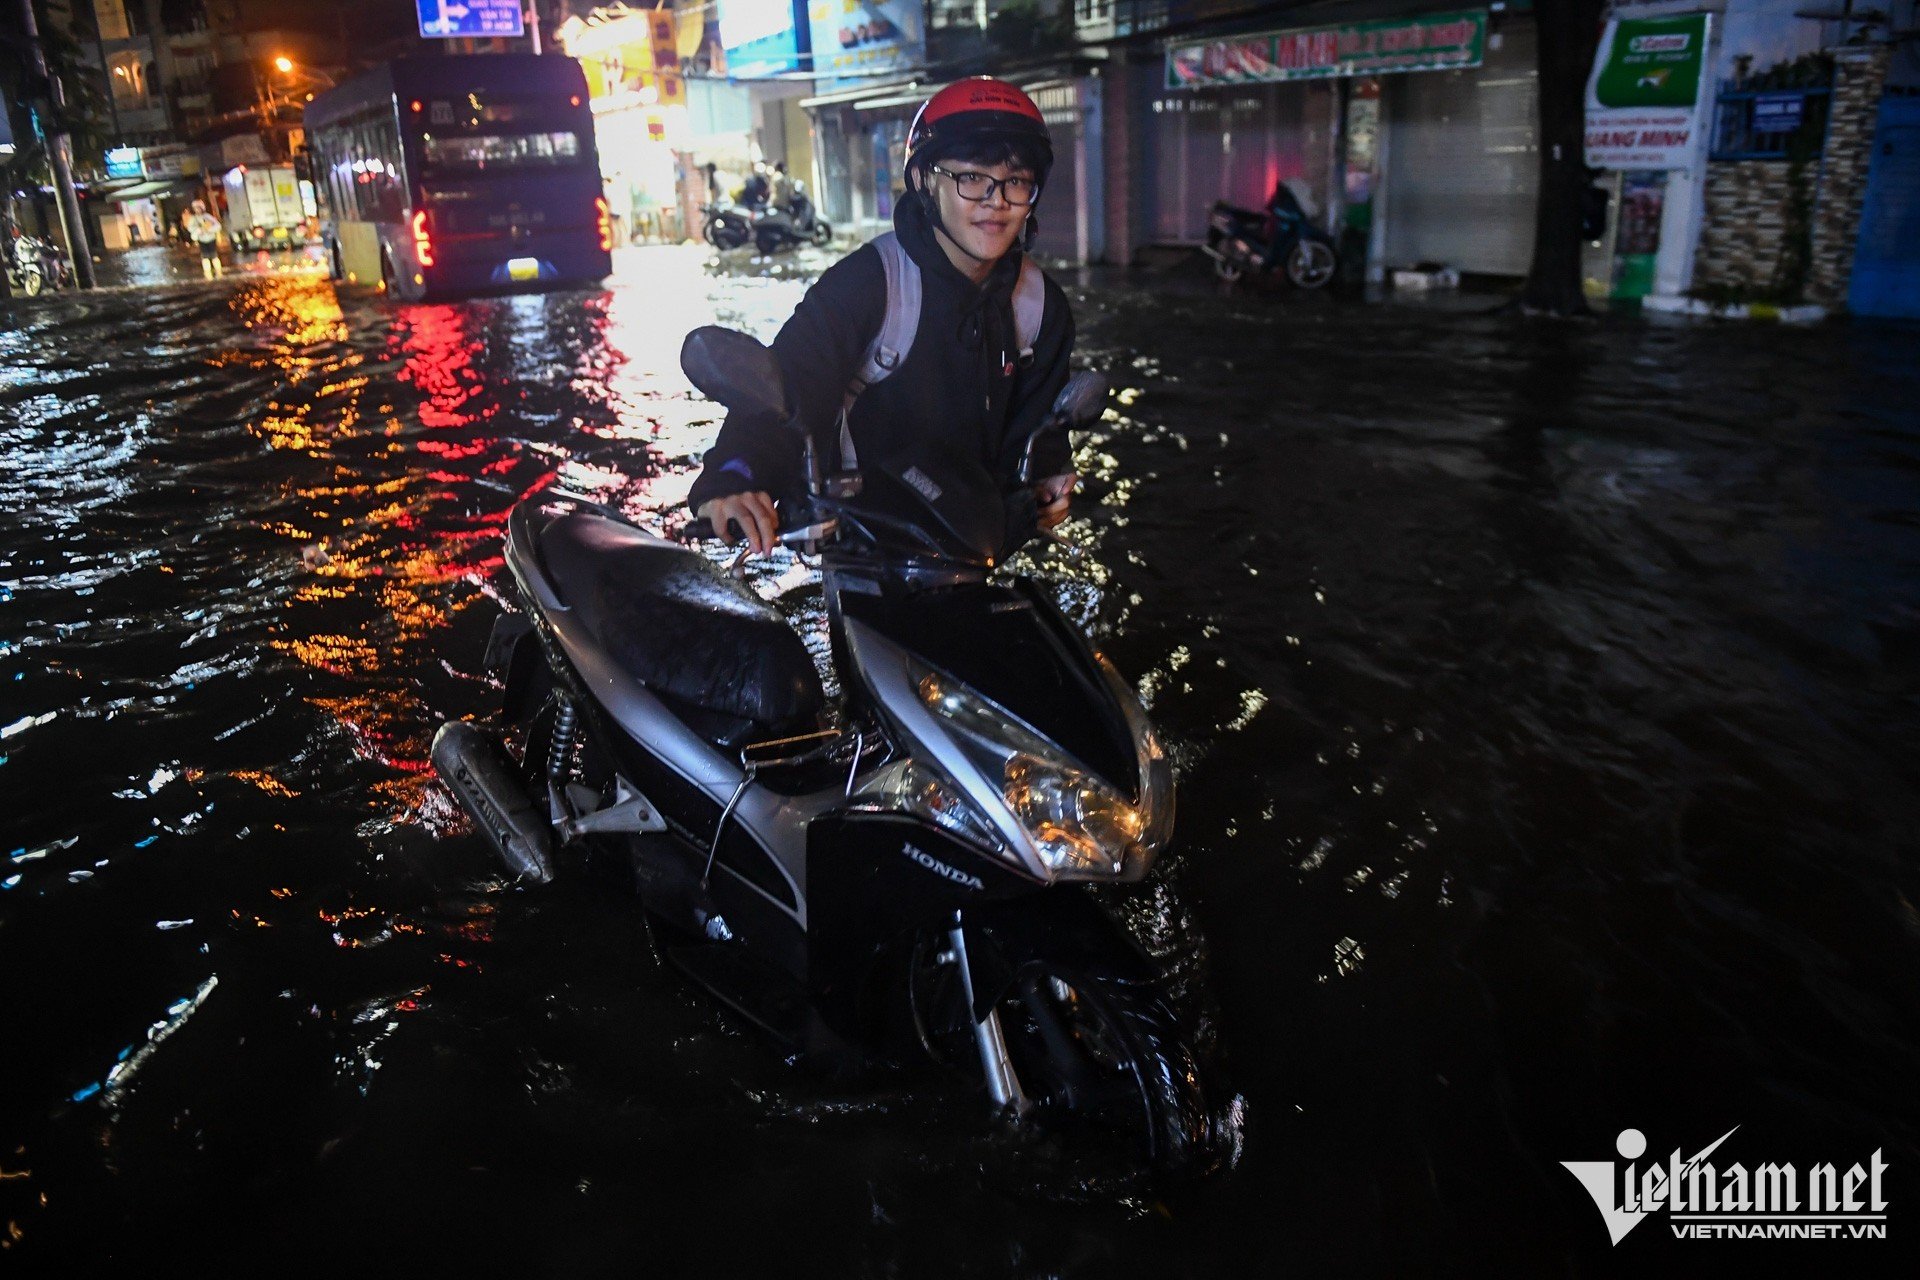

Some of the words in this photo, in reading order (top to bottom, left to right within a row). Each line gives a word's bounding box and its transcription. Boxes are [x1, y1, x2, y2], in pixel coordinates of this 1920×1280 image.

[1584, 131, 1636, 148] UANG
[1640, 131, 1690, 147] MINH
[902, 840, 985, 890] HONDA
